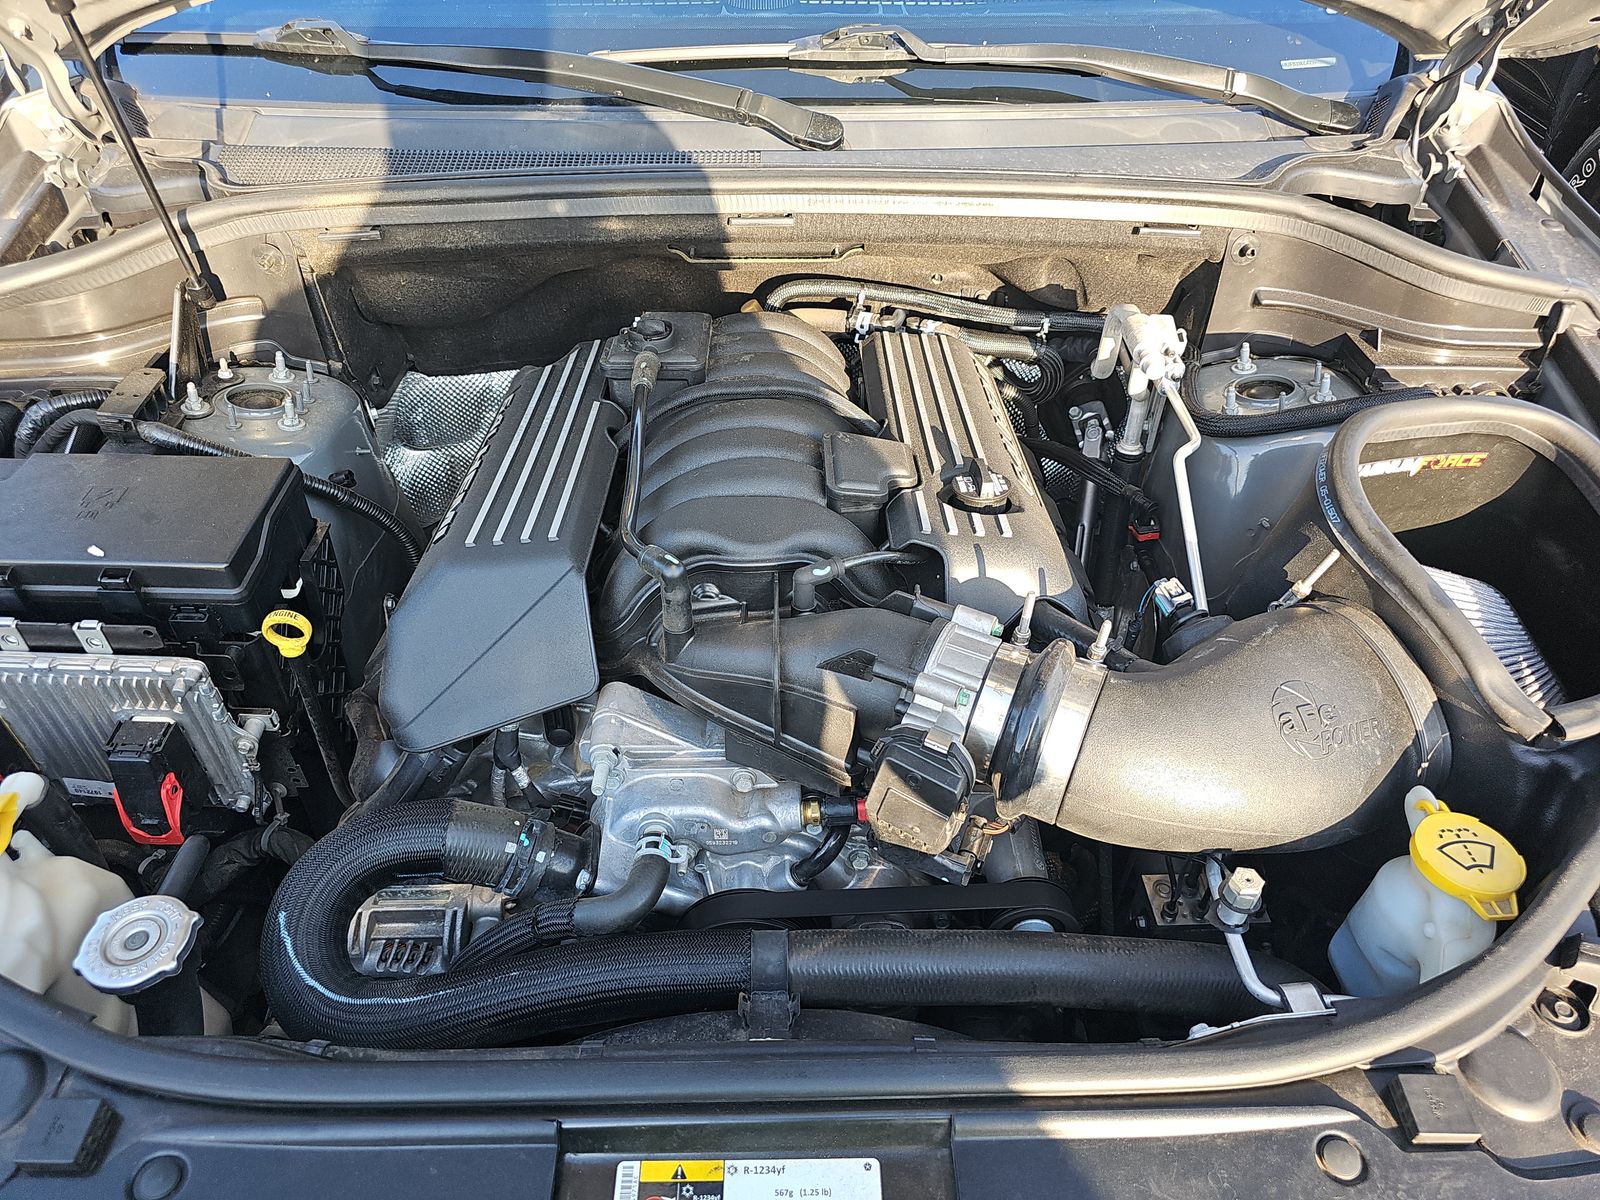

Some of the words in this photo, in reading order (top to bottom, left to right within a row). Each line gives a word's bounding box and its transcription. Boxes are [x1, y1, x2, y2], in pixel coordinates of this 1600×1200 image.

[268, 610, 300, 621] ENGINE
[1320, 717, 1382, 756] POWER
[110, 900, 150, 922] KEEP
[743, 1164, 786, 1176] R-1234yf
[774, 1188, 794, 1198] 567g
[799, 1187, 819, 1198] (1.25
[821, 1187, 832, 1198] lb)
